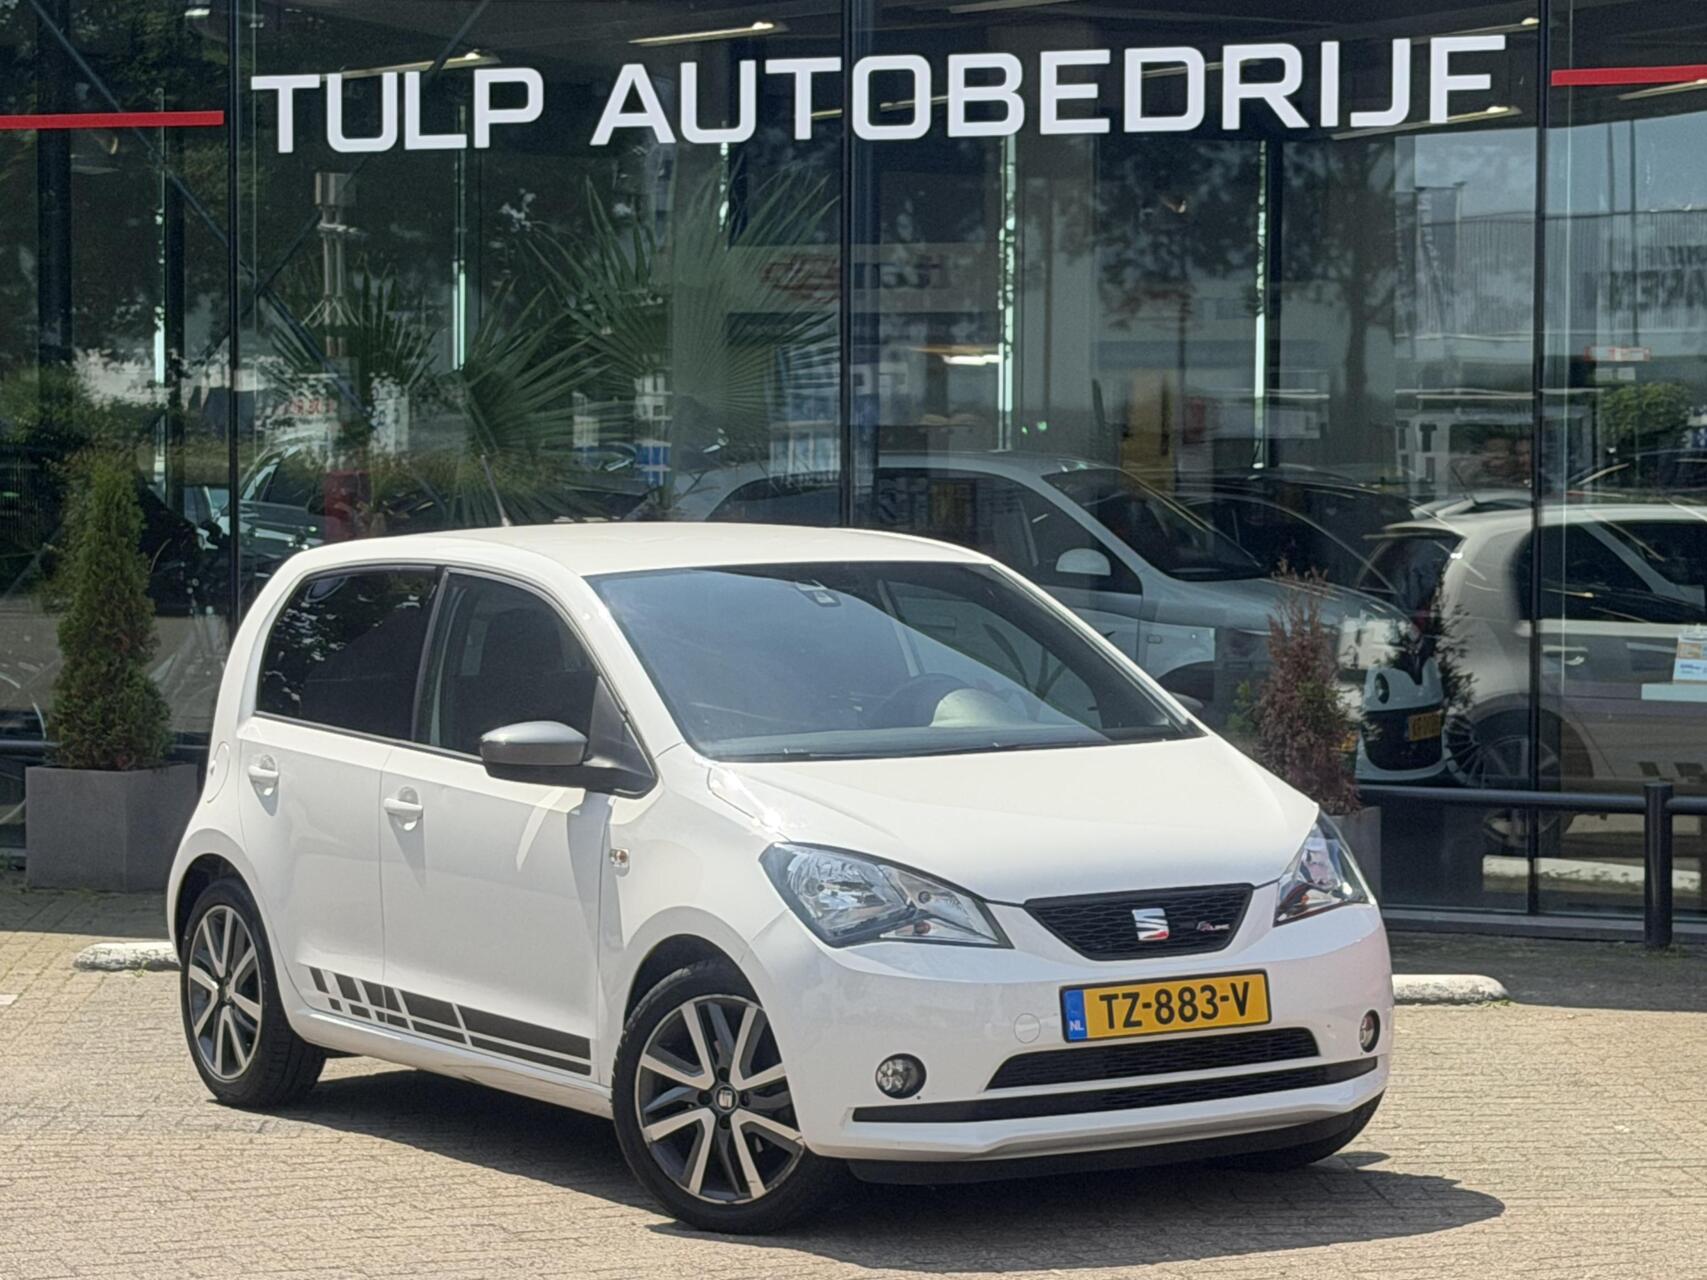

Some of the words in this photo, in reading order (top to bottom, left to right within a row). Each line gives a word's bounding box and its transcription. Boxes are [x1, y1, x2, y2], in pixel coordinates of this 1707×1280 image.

[251, 67, 543, 153] TULP
[590, 34, 1506, 145] AUTOBEDRIJF
[1069, 1019, 1085, 1032] NL
[1098, 981, 1250, 1030] TZ-883-V
